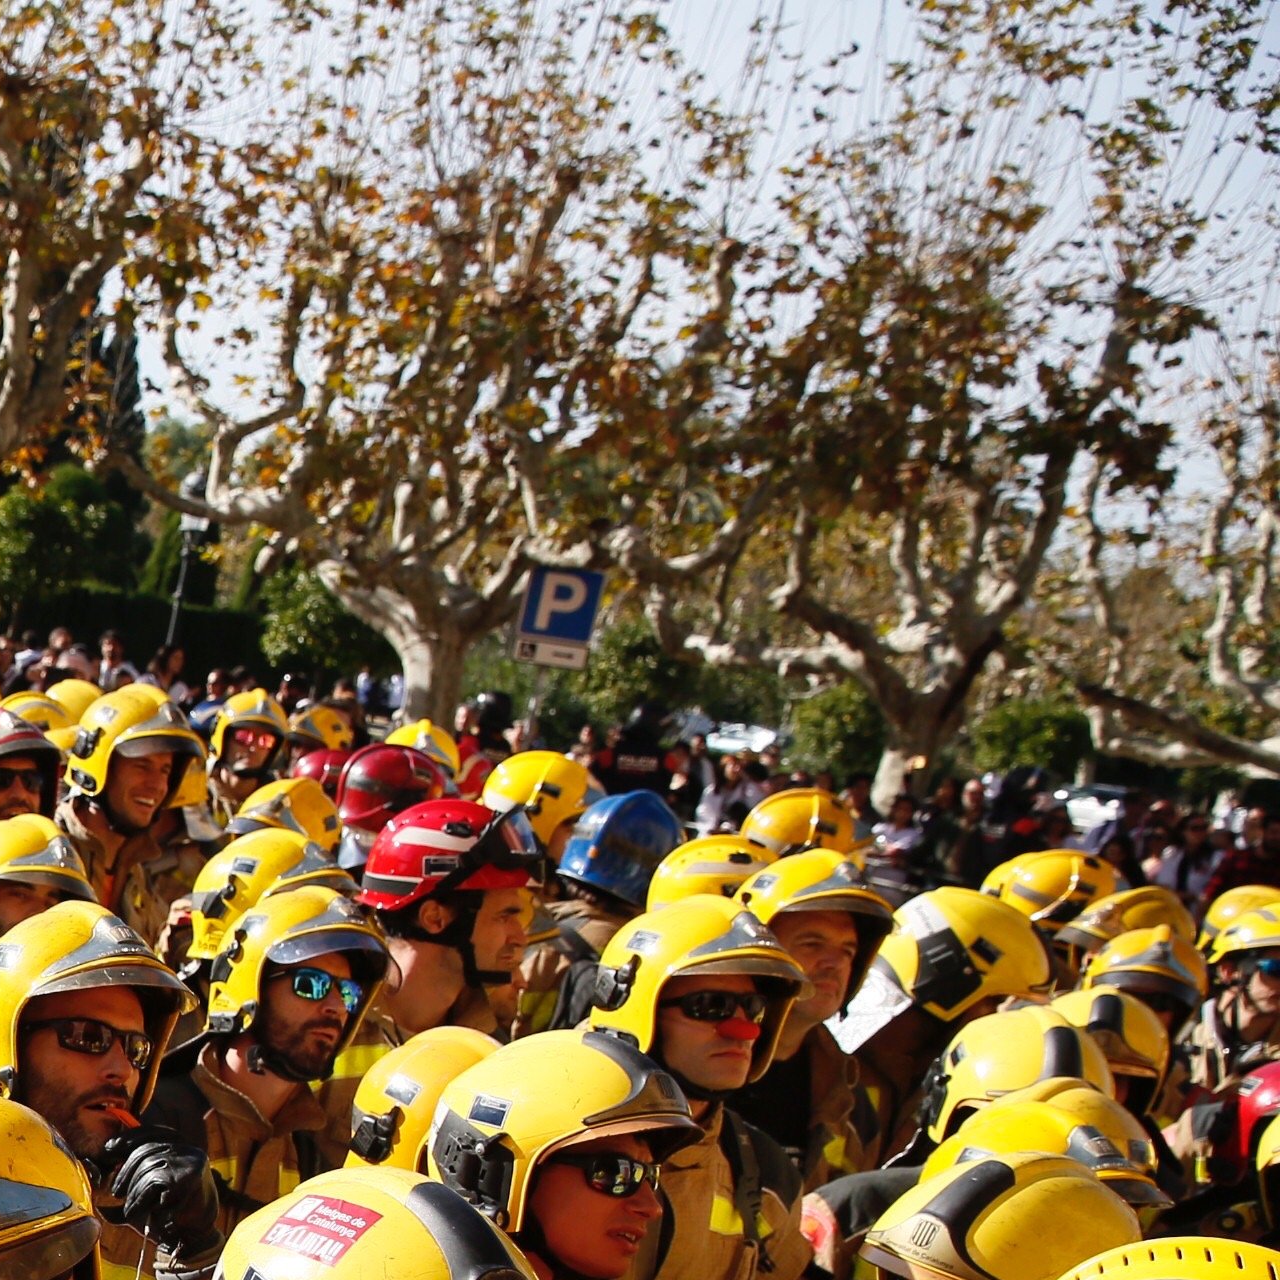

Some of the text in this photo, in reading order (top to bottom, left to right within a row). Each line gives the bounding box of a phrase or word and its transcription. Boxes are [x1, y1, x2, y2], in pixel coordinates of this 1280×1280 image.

[534, 572, 587, 631] P
[306, 1214, 357, 1239] Catalunya
[315, 1204, 366, 1229] Metges de
